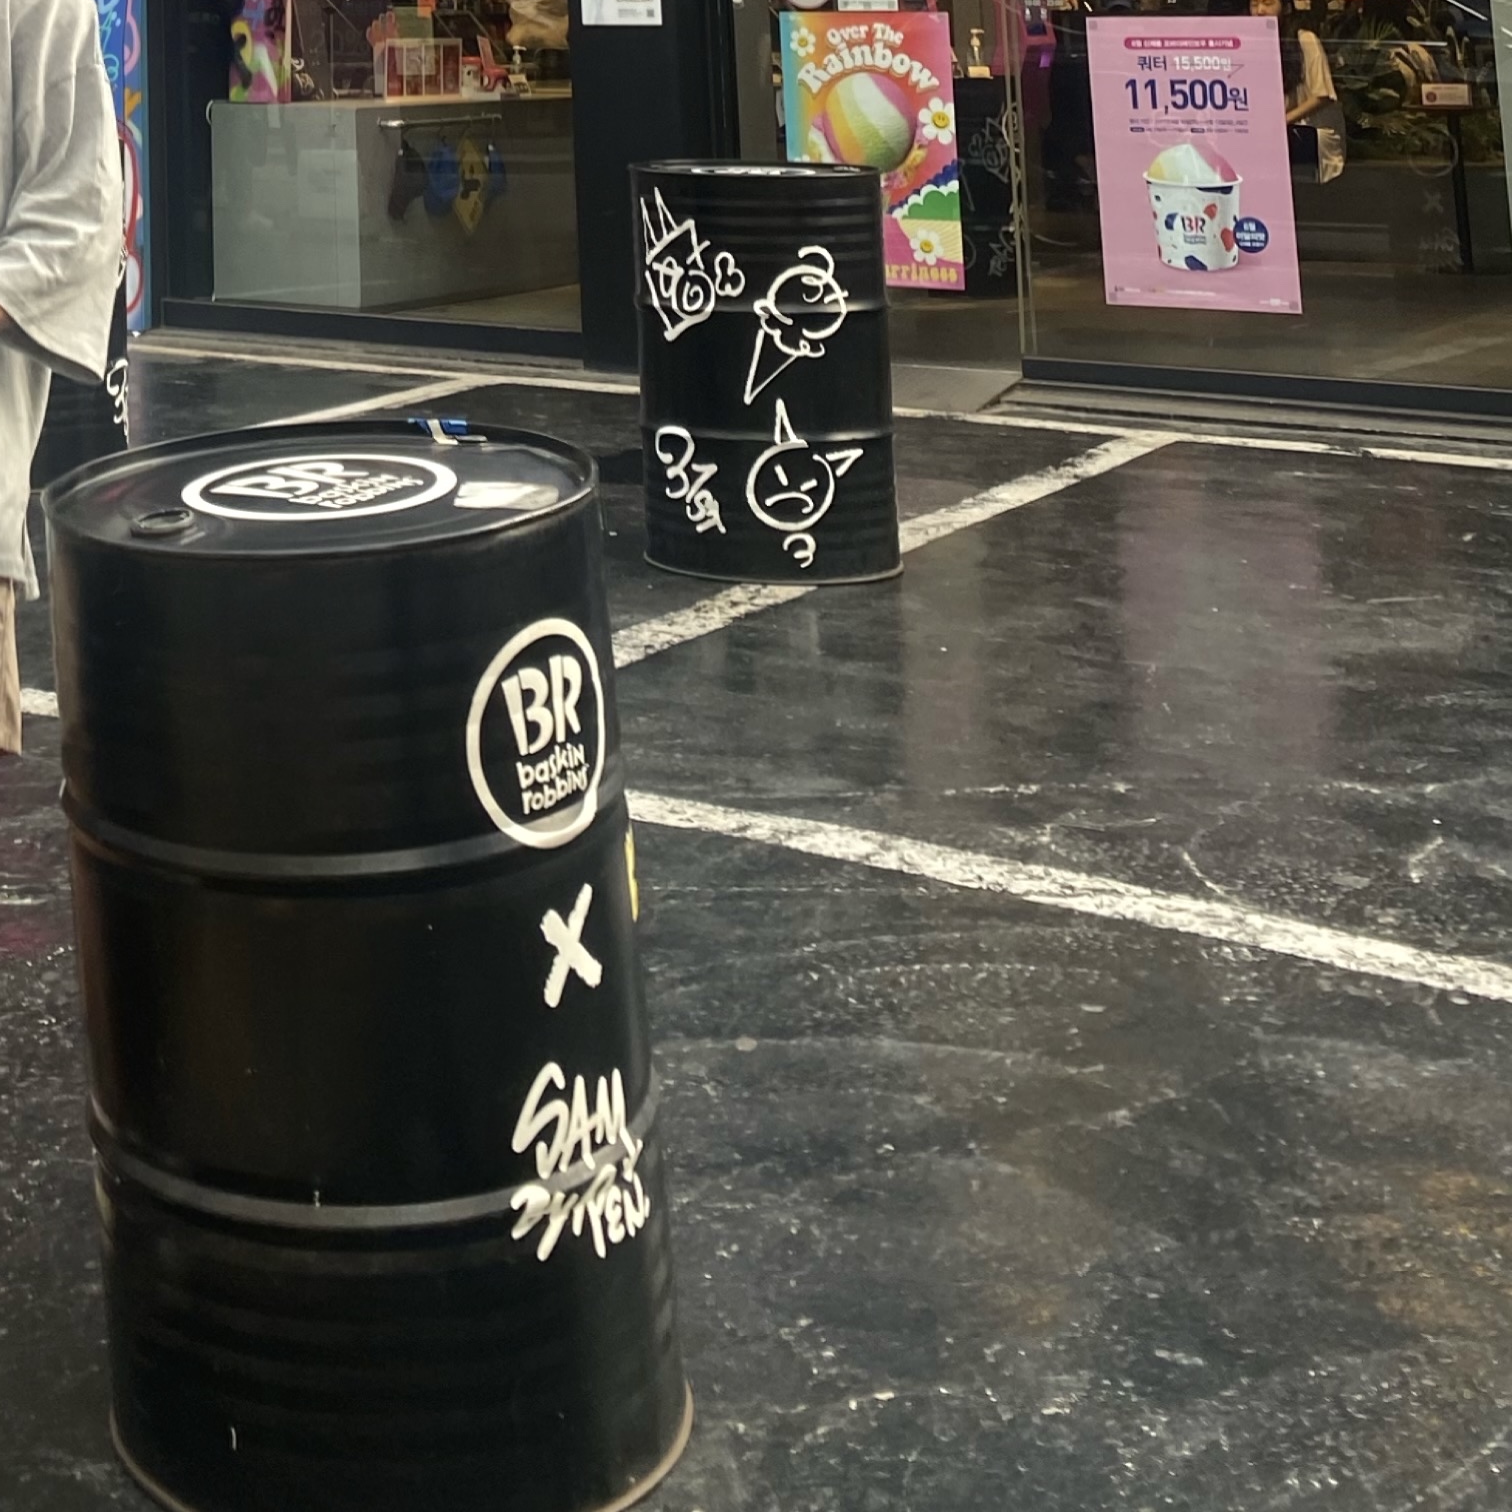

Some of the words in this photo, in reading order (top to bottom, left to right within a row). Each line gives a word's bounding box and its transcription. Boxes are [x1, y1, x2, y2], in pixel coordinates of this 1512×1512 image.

[827, 24, 869, 47] Over
[873, 22, 904, 47] The
[797, 41, 940, 96] Rainbow
[1137, 54, 1167, 71] 쿼터
[1125, 78, 1249, 115] 11,500원
[208, 461, 370, 499] BR
[501, 654, 582, 756] BR
